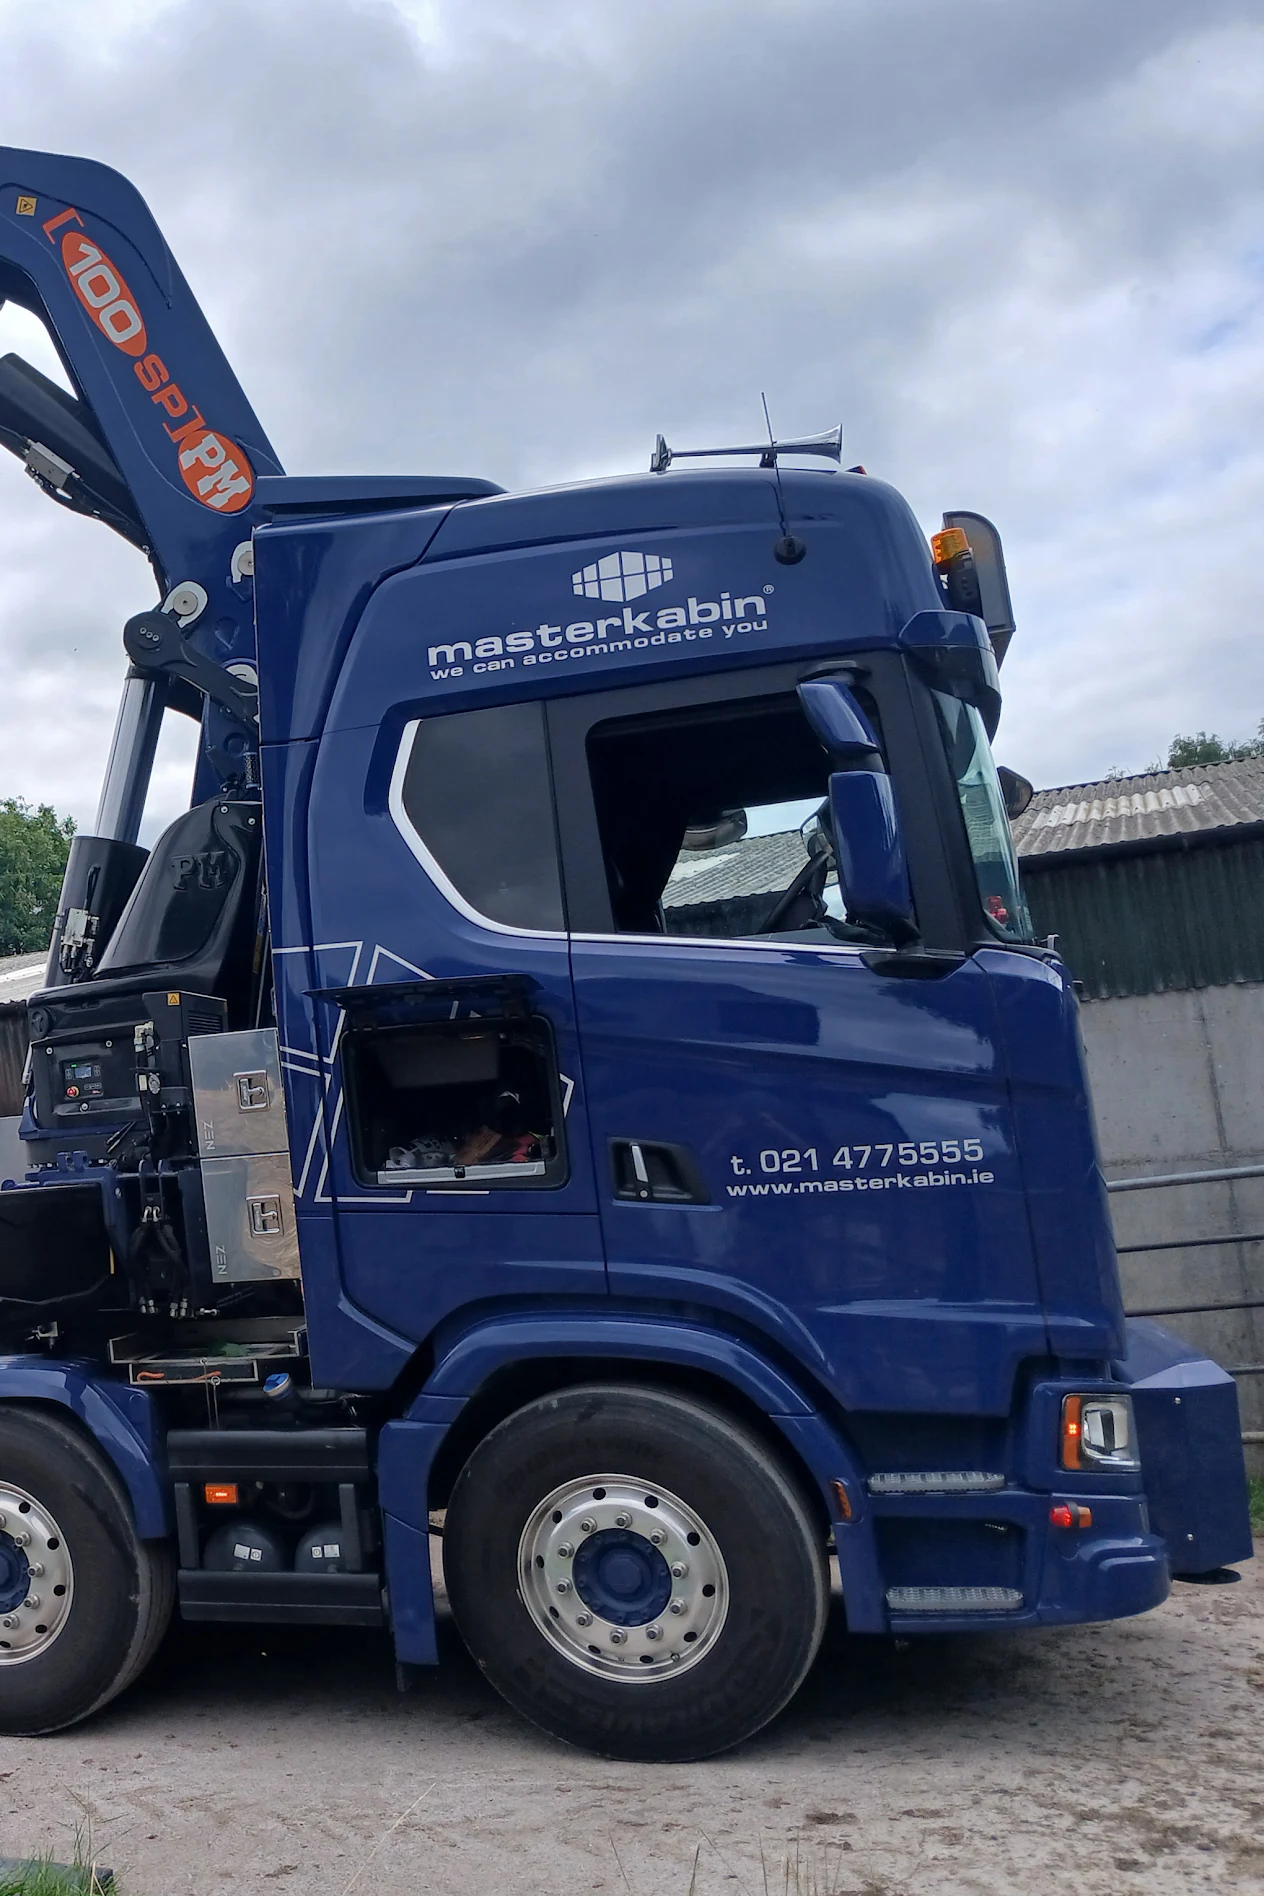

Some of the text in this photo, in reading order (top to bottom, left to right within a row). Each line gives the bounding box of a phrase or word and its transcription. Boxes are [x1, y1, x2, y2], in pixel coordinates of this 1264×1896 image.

[179, 432, 252, 509] PM
[430, 619, 768, 680] we can accommodate you
[729, 1137, 985, 1175] t. 021 4775555
[726, 1168, 995, 1198] www.masterkabin.ie
